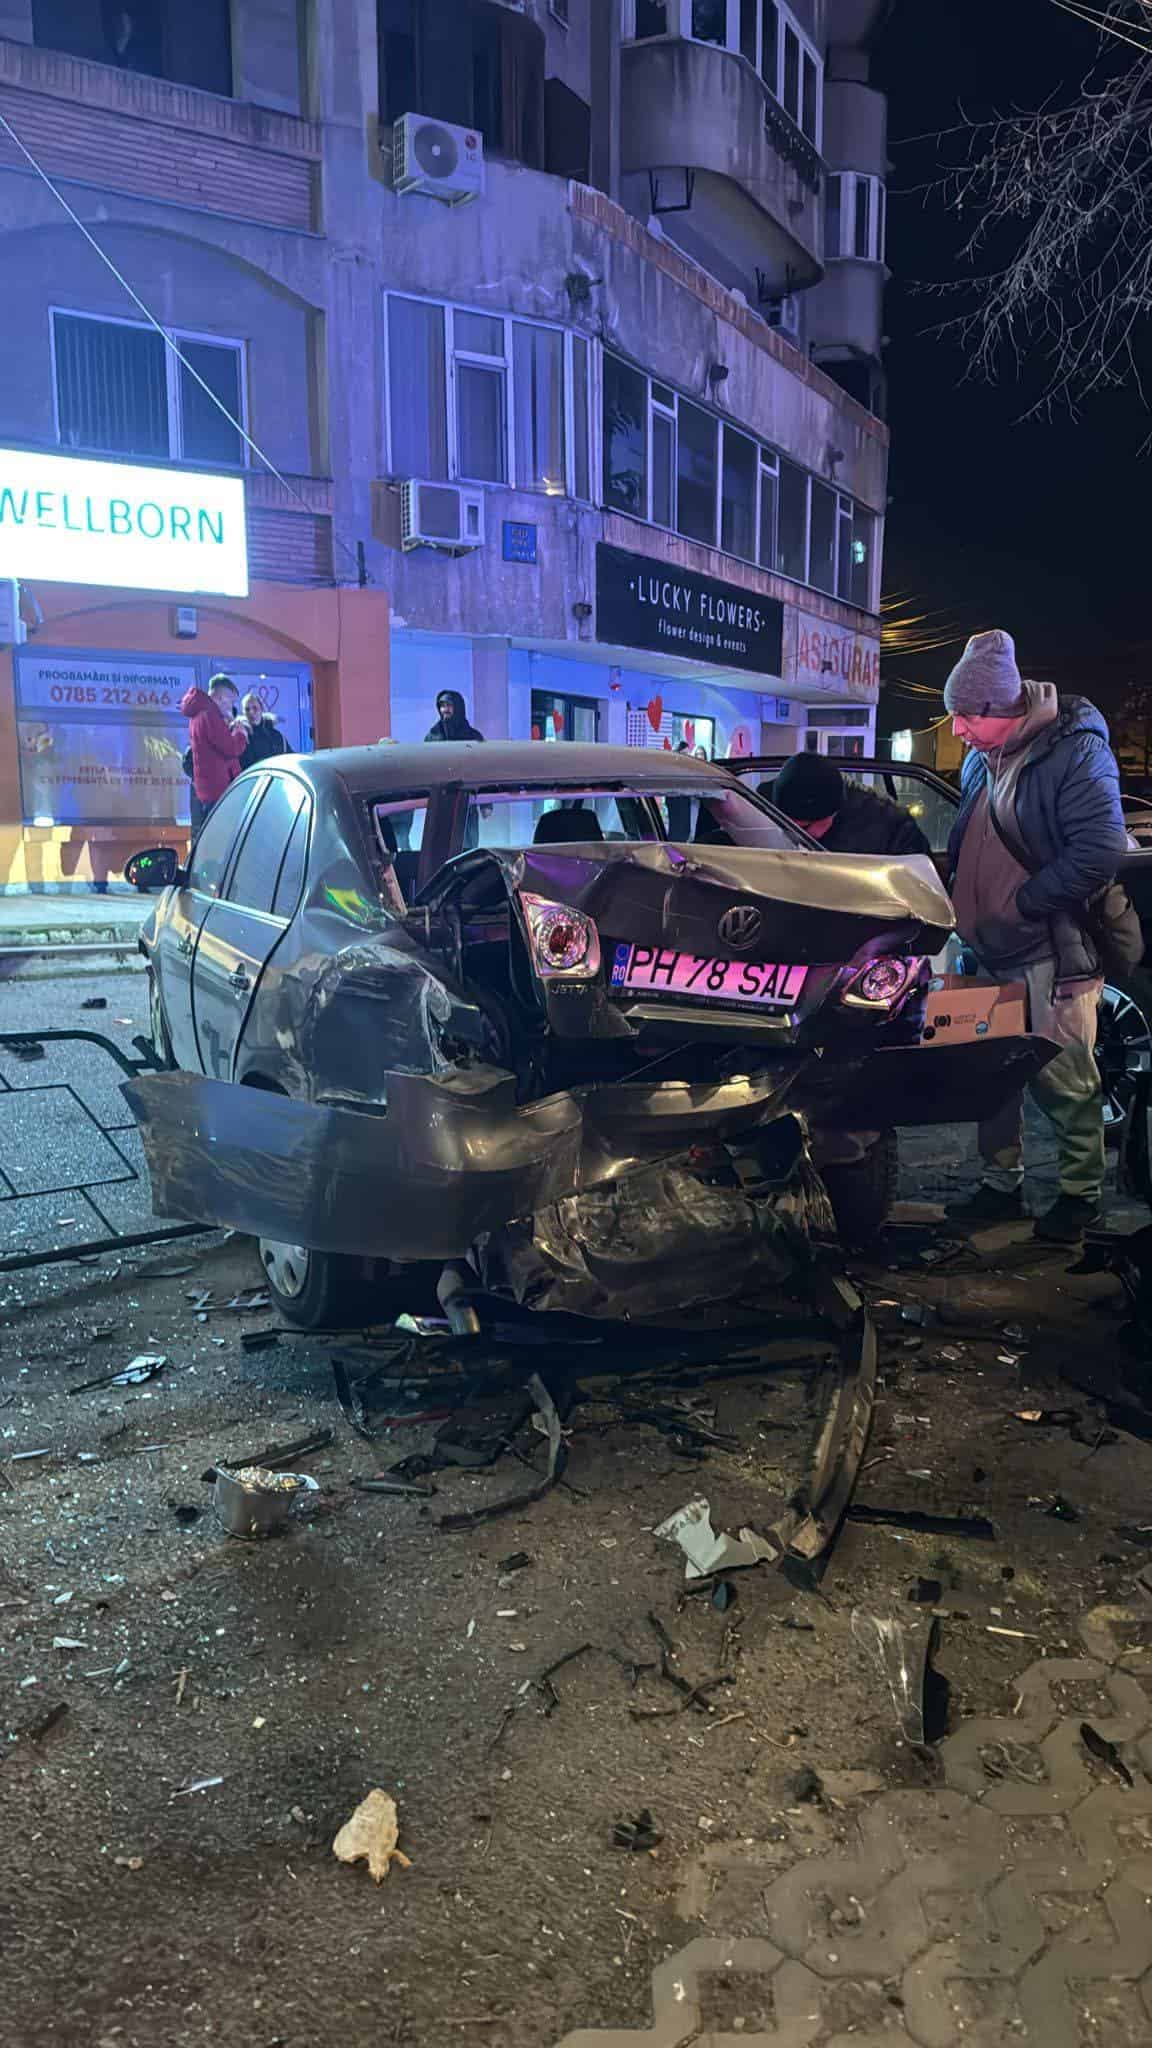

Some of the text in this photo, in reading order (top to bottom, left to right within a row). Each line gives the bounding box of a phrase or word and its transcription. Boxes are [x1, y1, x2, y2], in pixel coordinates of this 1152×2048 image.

[0, 487, 225, 544] WELLBORN
[637, 575, 761, 632] LUCKY FLOWERS
[658, 619, 747, 654] flower design & events
[50, 686, 97, 704] 0785
[102, 688, 131, 705] 212
[612, 943, 795, 1000] RO PH 78 SAL
